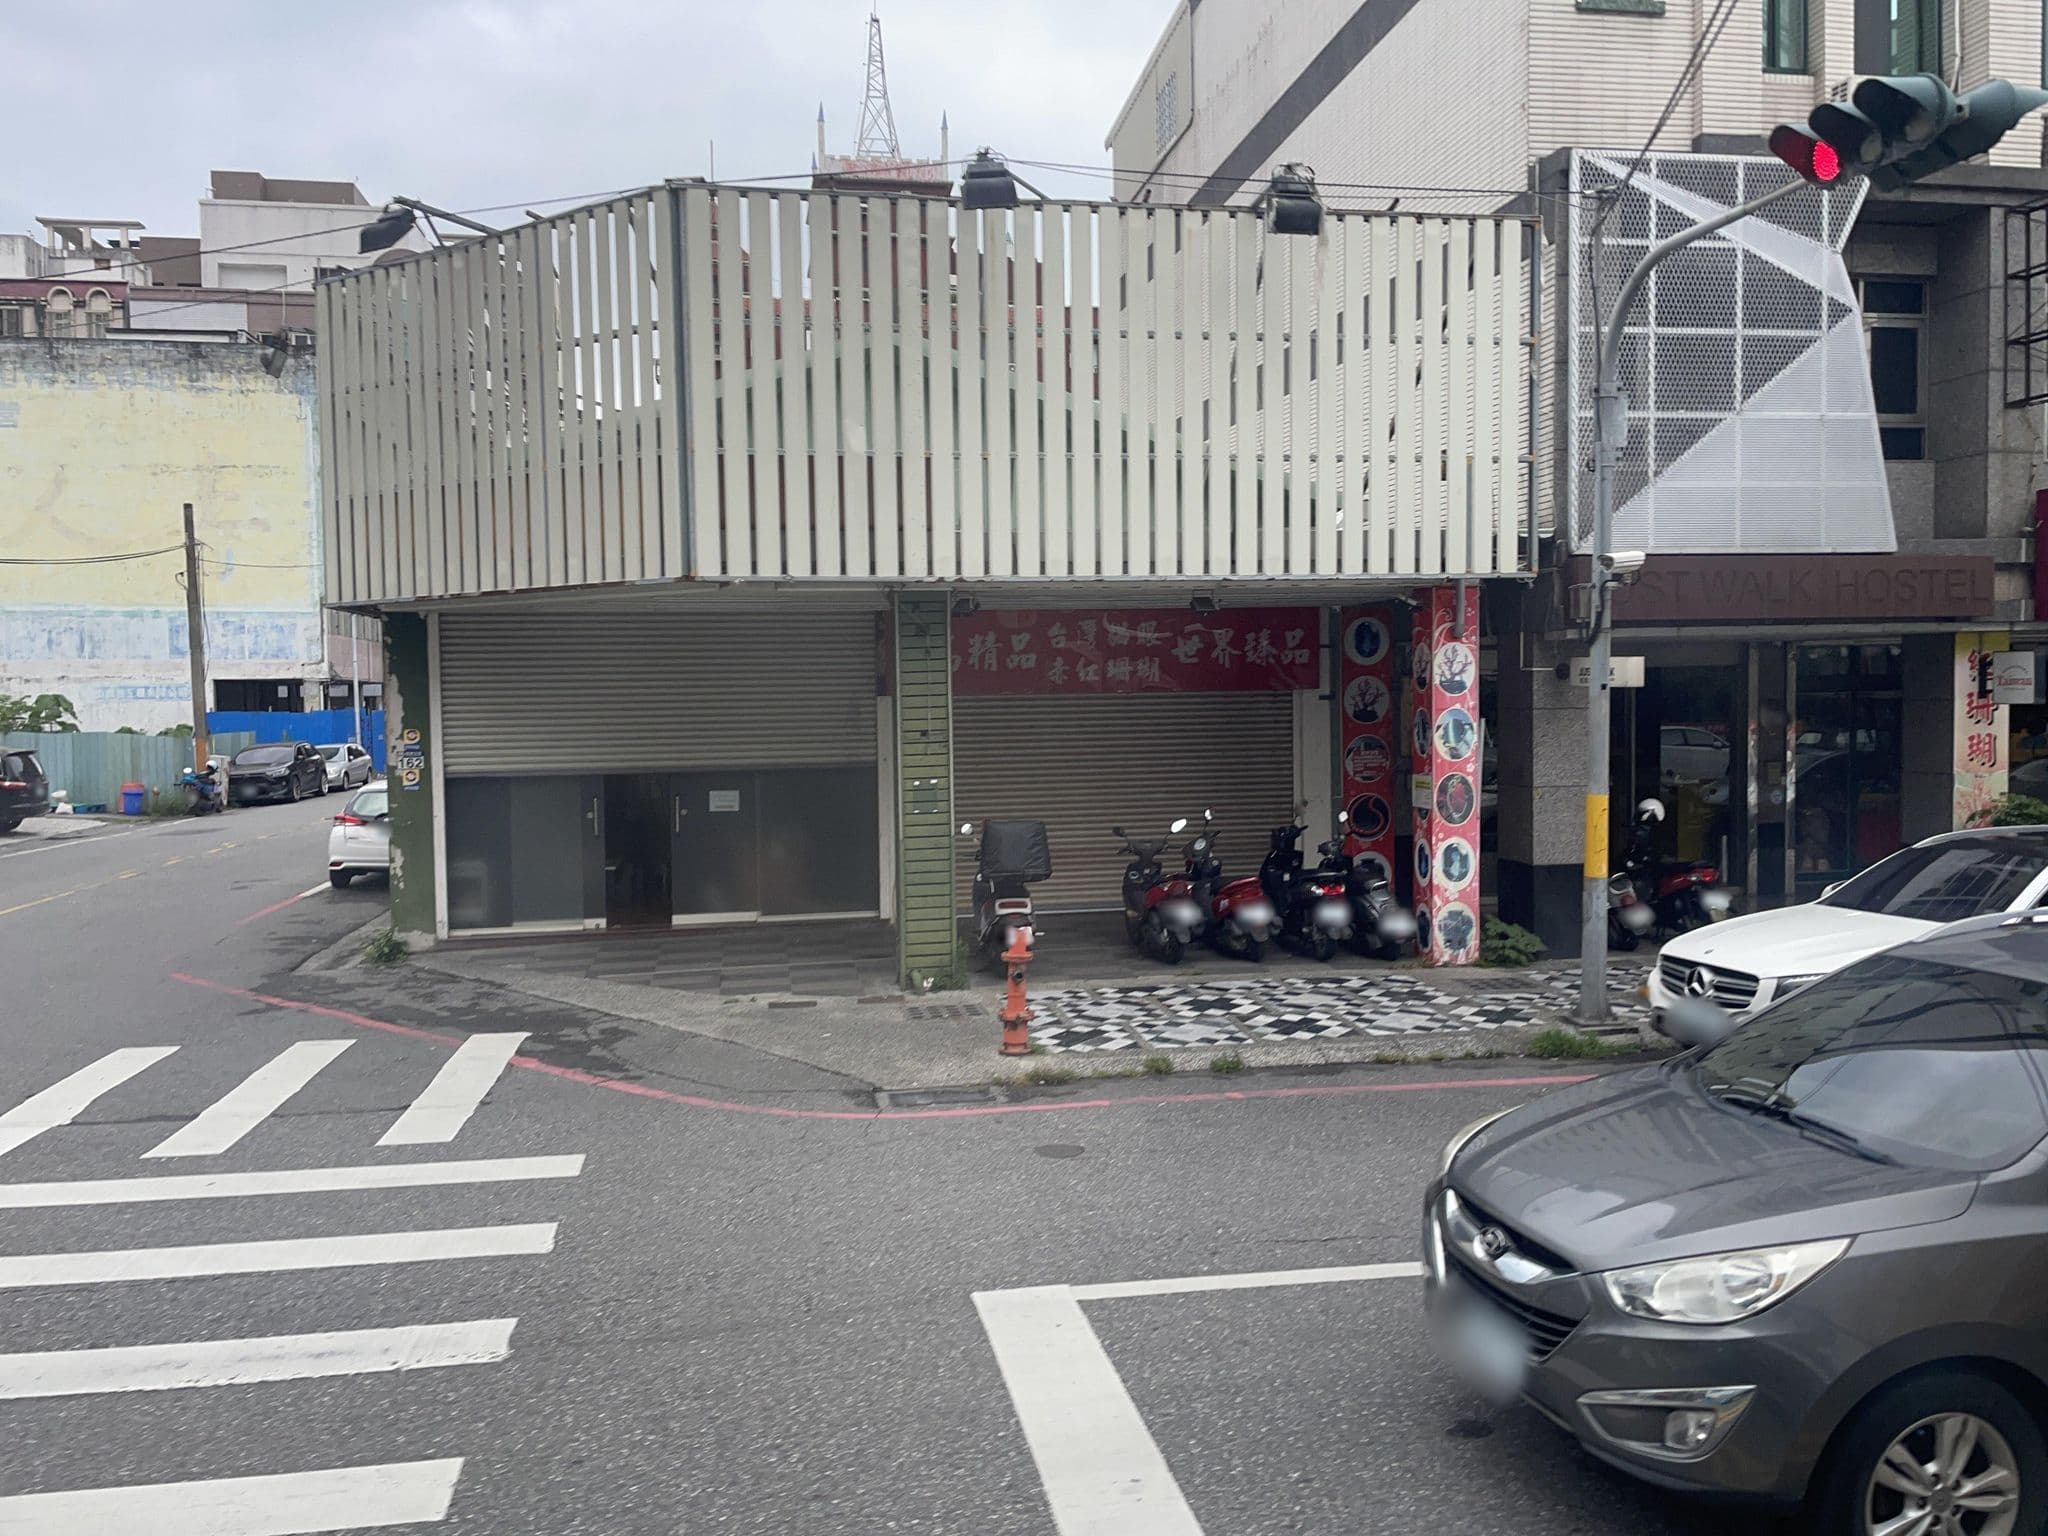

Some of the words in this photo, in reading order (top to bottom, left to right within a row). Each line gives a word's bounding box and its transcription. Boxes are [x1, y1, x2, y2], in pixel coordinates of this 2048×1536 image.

[1704, 569, 1814, 603] WALK
[1833, 568, 1988, 602] HOSTEL
[399, 757, 423, 769] 162
